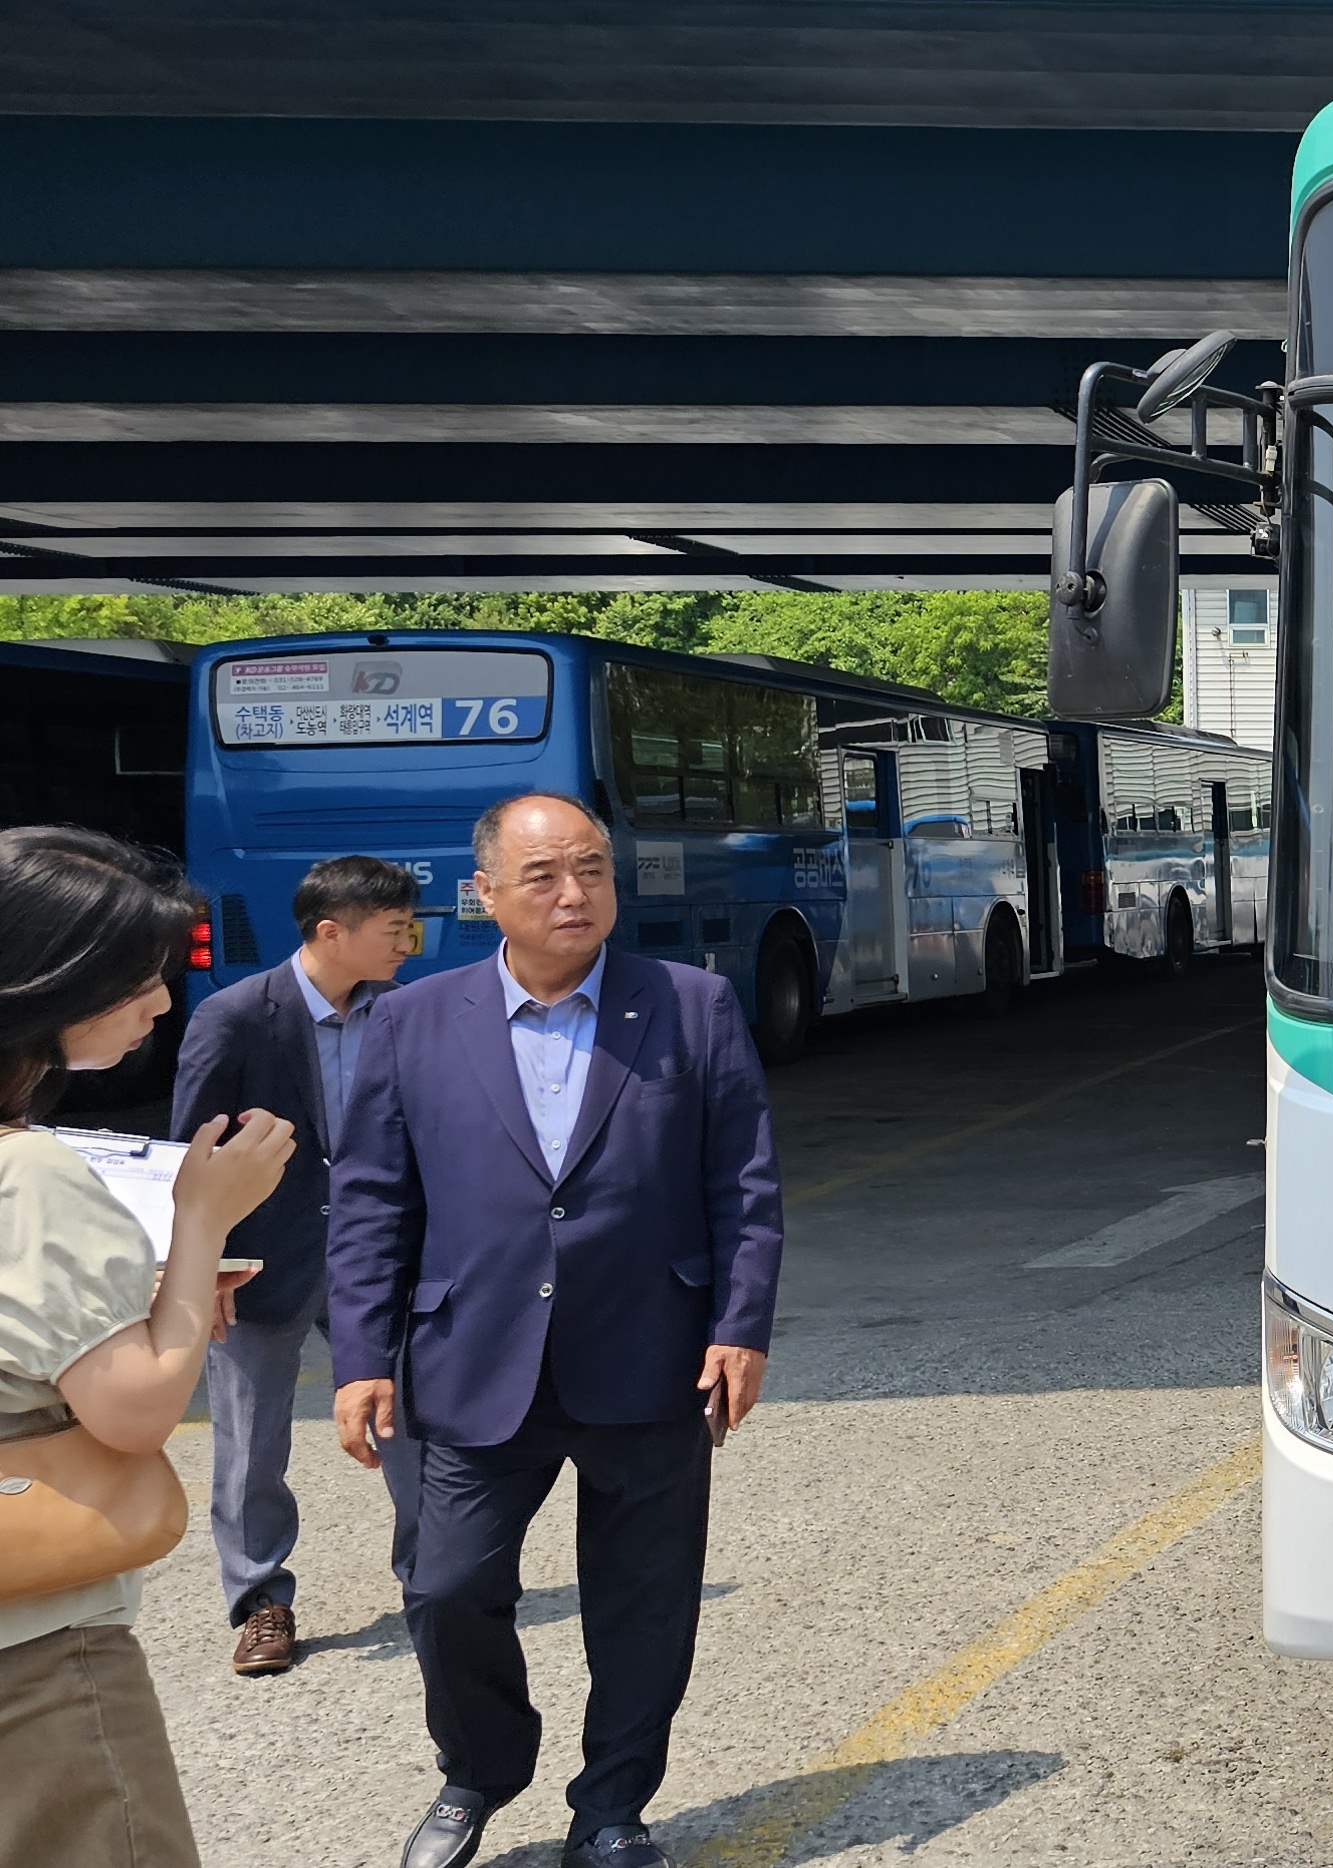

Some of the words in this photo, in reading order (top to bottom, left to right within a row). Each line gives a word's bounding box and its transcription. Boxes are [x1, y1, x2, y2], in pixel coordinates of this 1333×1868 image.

[235, 705, 284, 723] 수택동
[384, 703, 433, 734] 석계역
[455, 698, 519, 736] 76
[235, 723, 284, 740] (차고지)
